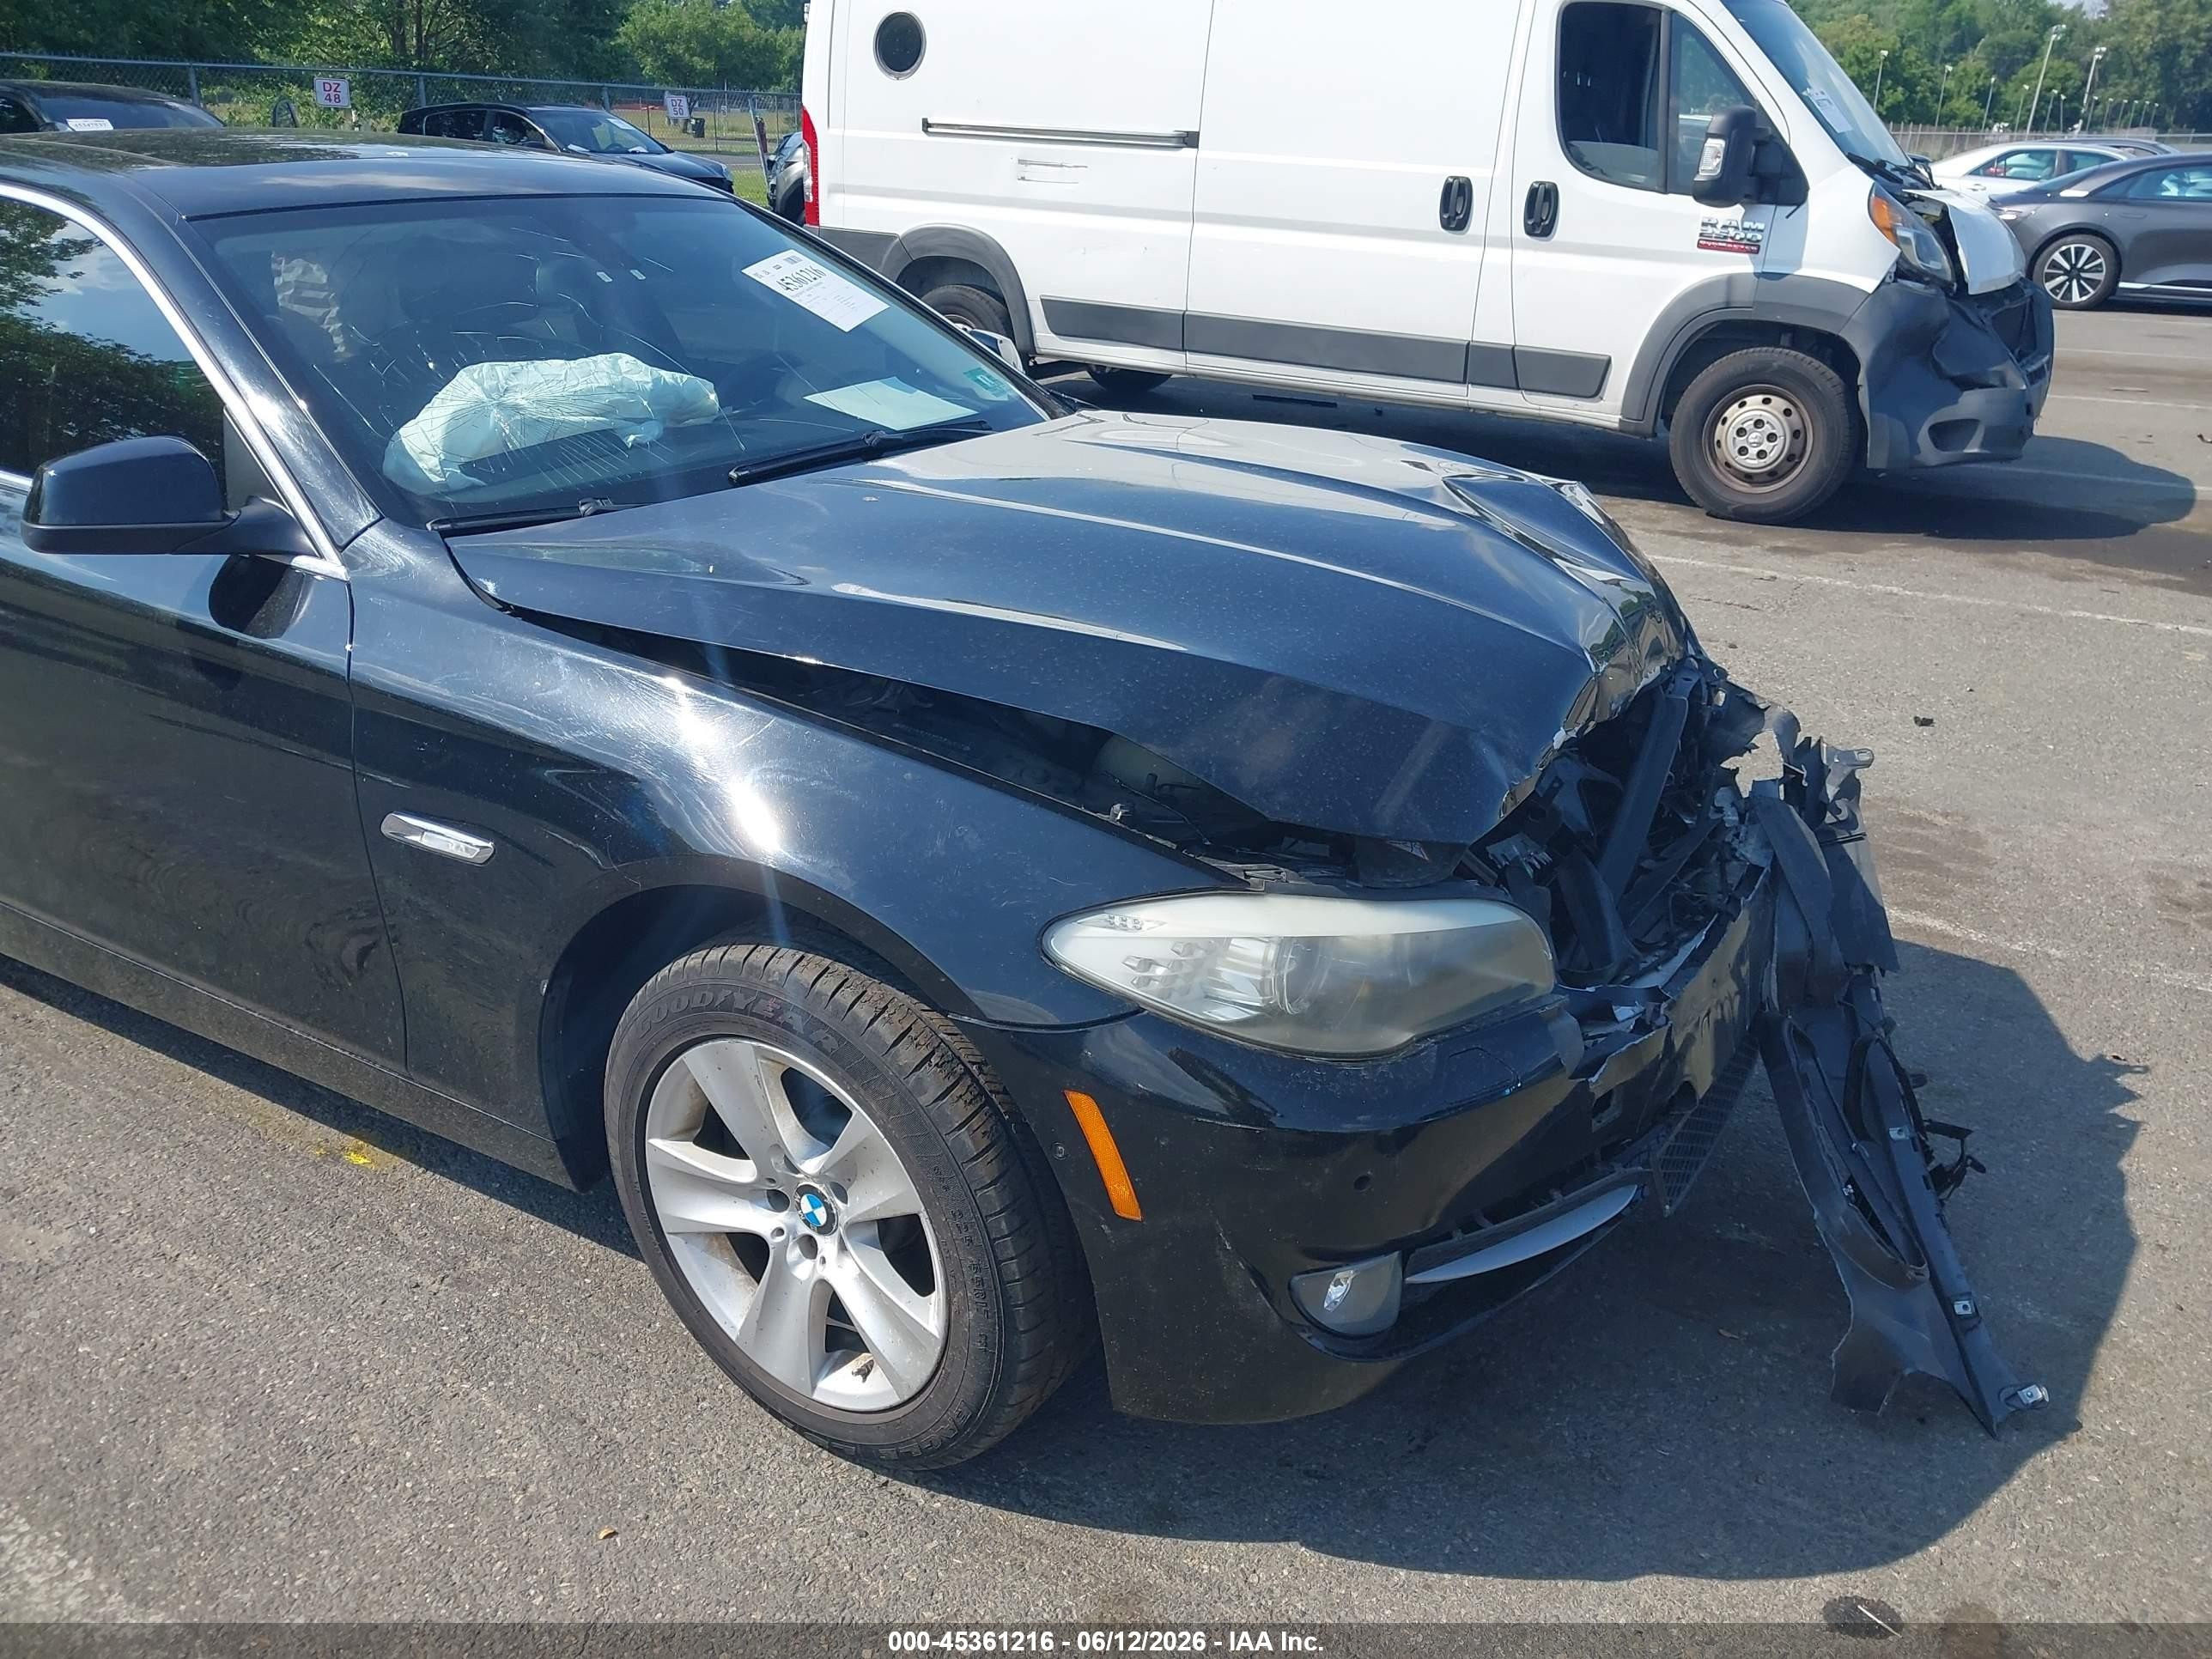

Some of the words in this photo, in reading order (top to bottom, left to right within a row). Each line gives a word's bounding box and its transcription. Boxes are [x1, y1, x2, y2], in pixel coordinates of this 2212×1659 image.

[323, 82, 341, 93] DZ
[325, 93, 341, 103] 48
[672, 99, 683, 107] DZ
[673, 107, 684, 116] 50
[1701, 216, 1765, 232] RAM
[776, 264, 827, 292] 45361216
[640, 989, 839, 1054] GOODYEAR
[878, 1400, 972, 1460] EAGLE
